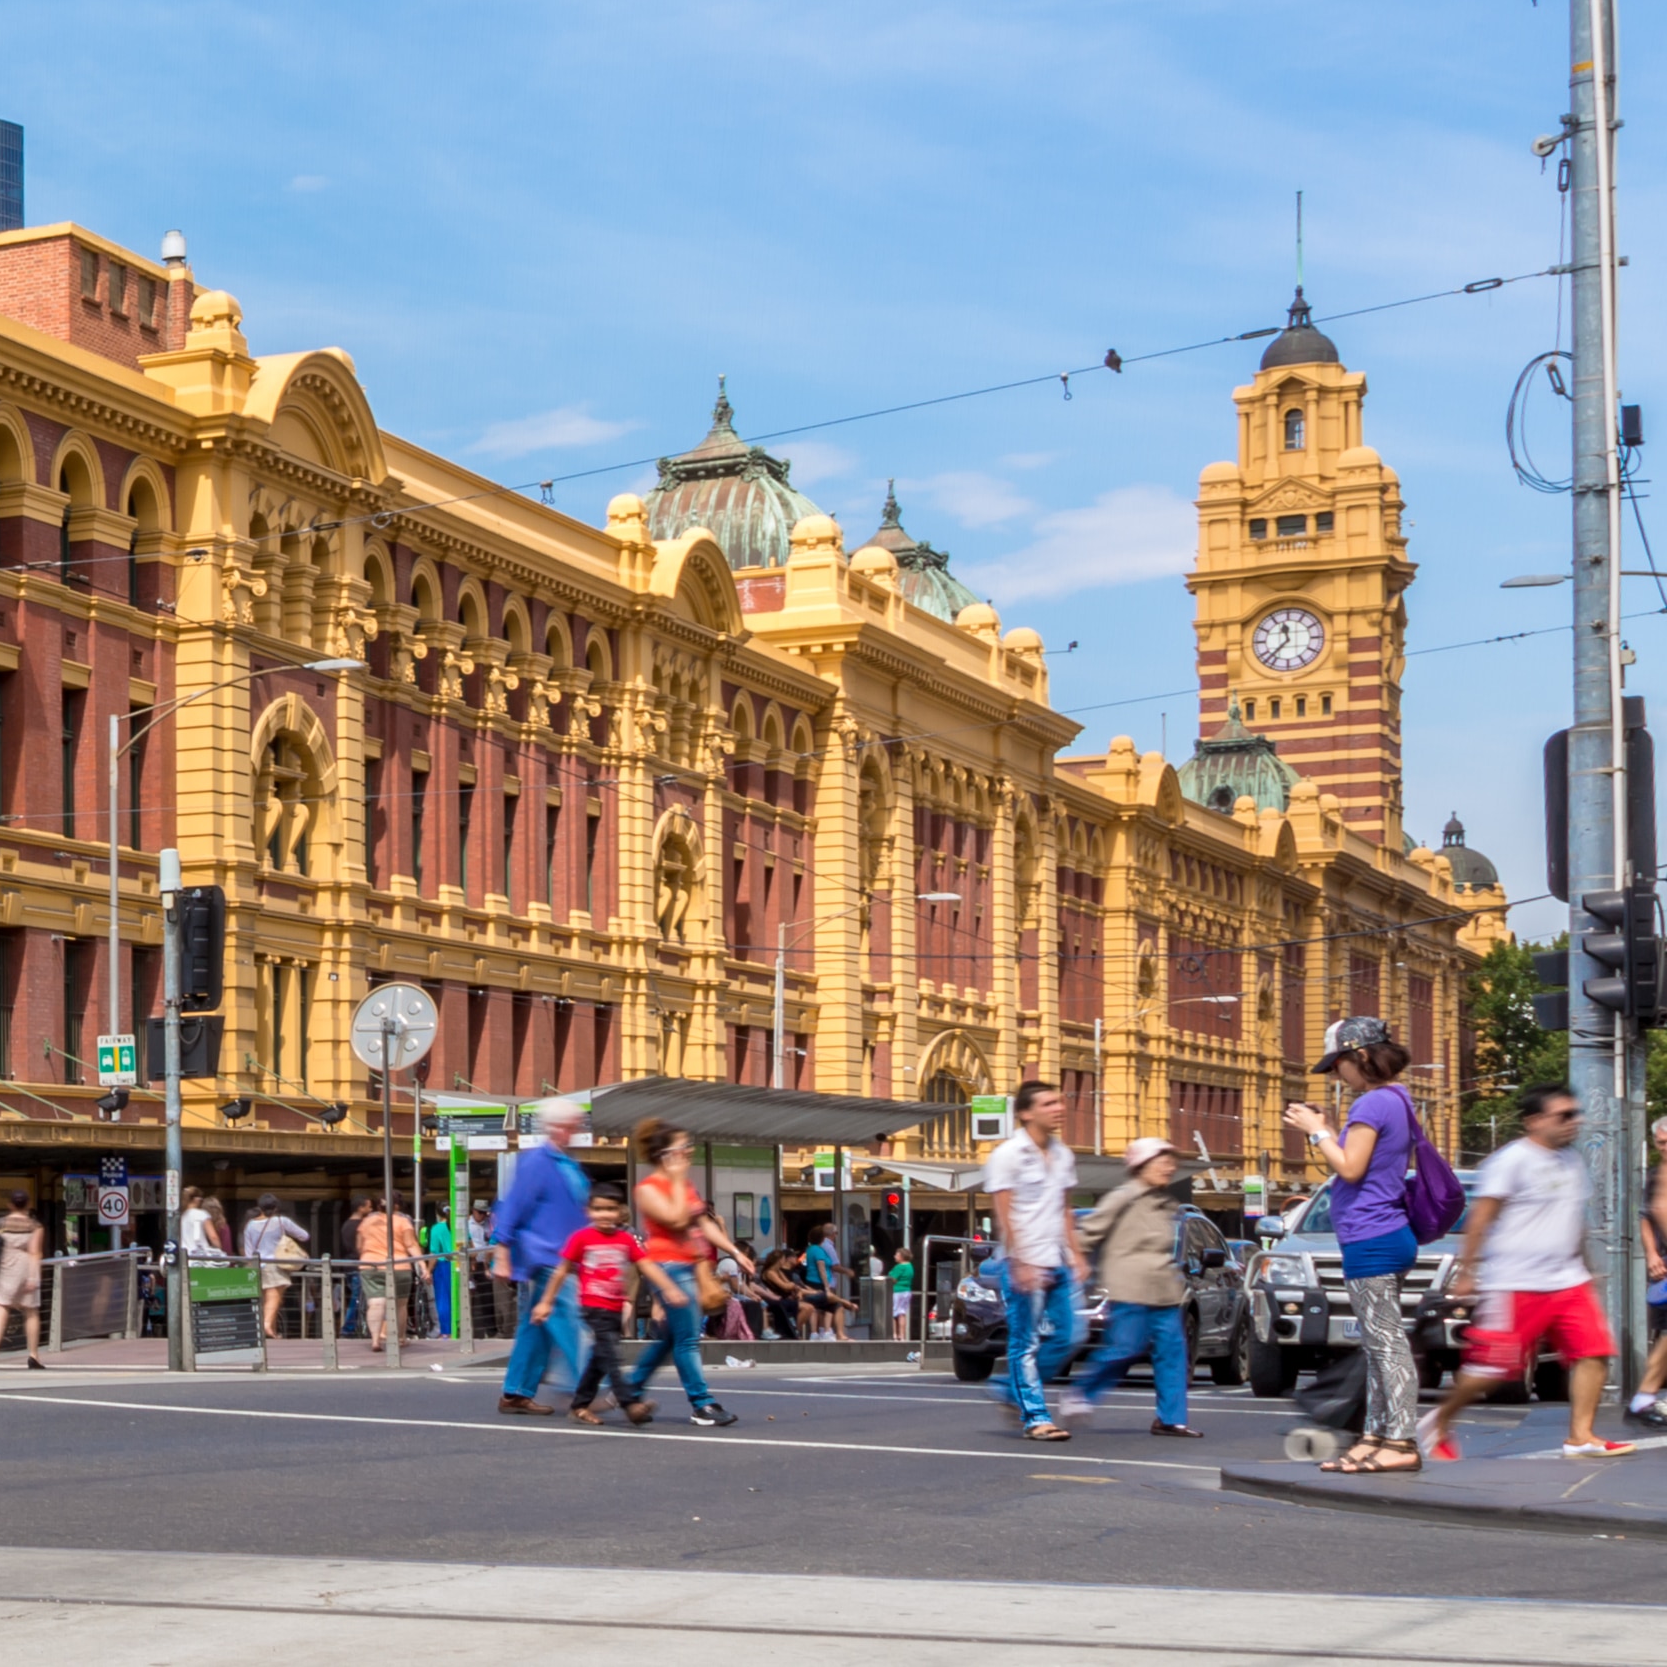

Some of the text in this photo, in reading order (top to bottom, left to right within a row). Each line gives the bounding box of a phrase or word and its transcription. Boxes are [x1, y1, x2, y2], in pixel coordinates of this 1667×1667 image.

[99, 1036, 131, 1045] FAIRWAY
[102, 1171, 124, 1179] Police
[103, 1198, 124, 1213] 40
